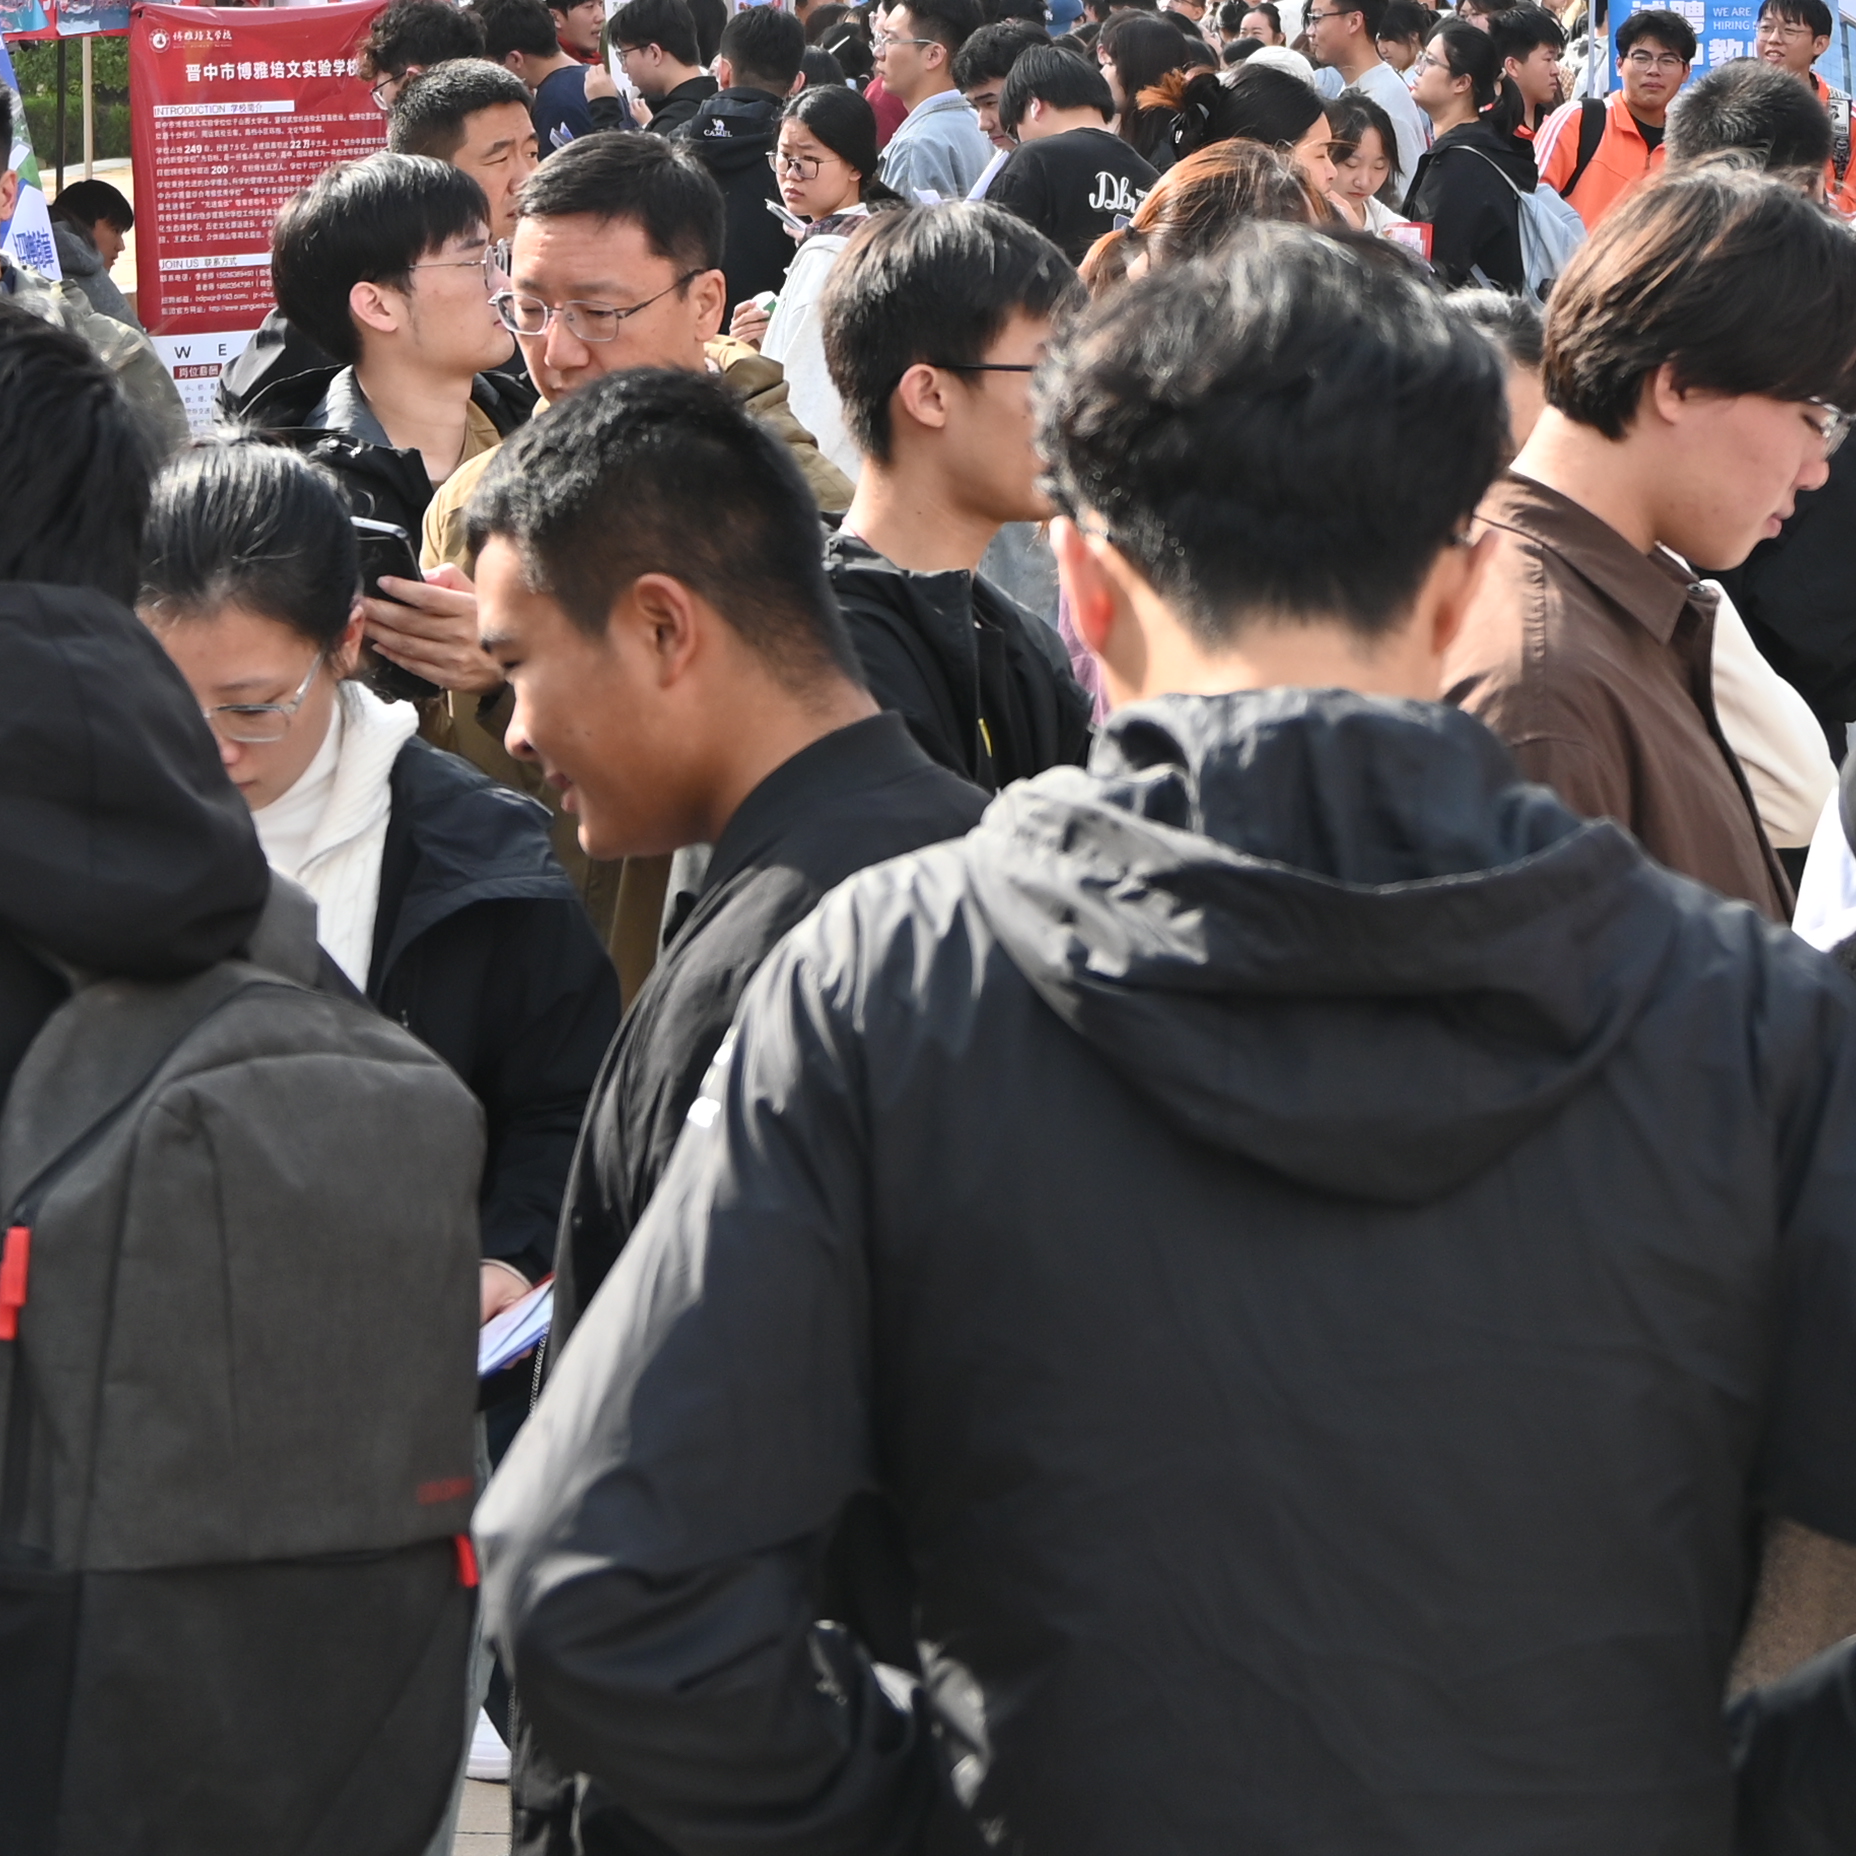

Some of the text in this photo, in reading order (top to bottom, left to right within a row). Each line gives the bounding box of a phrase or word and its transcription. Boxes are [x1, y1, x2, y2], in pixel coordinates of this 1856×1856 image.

[1713, 6, 1752, 17] WE ARE
[1713, 21, 1750, 31] HIRING
[172, 29, 233, 41] 博雅培文学校
[185, 58, 359, 82] 晋中市博雅培文实验学校
[154, 103, 263, 116] INTRODUCTION 学校简介
[703, 128, 733, 139] CAMEL
[184, 144, 202, 154] 249
[211, 164, 229, 175] 200
[160, 257, 238, 270] JOIN US 联系方式
[174, 344, 227, 359] W E
